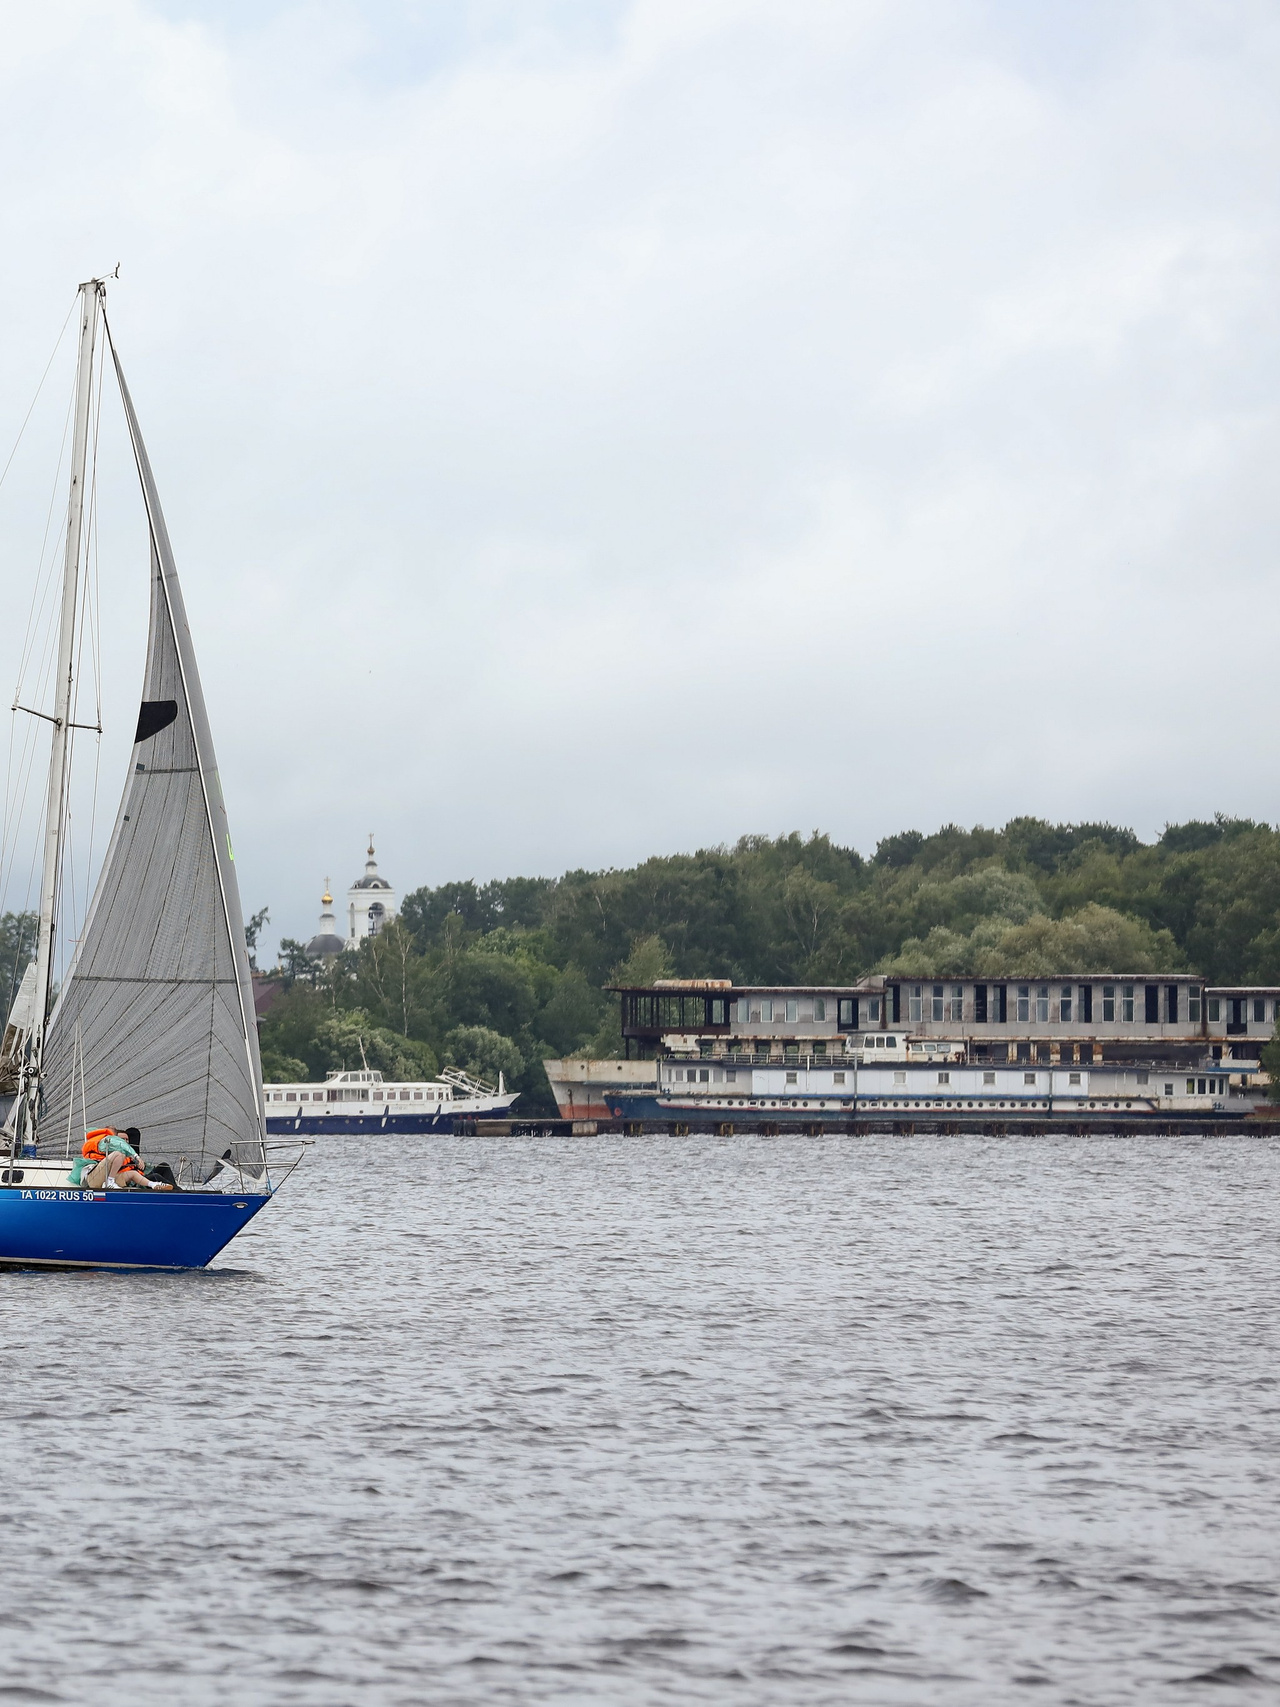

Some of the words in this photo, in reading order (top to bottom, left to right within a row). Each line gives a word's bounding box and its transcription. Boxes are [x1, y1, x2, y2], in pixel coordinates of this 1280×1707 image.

[20, 1190, 33, 1200] TA
[34, 1190, 57, 1200] 1022
[58, 1191, 80, 1201] RUS
[82, 1192, 94, 1202] 50
